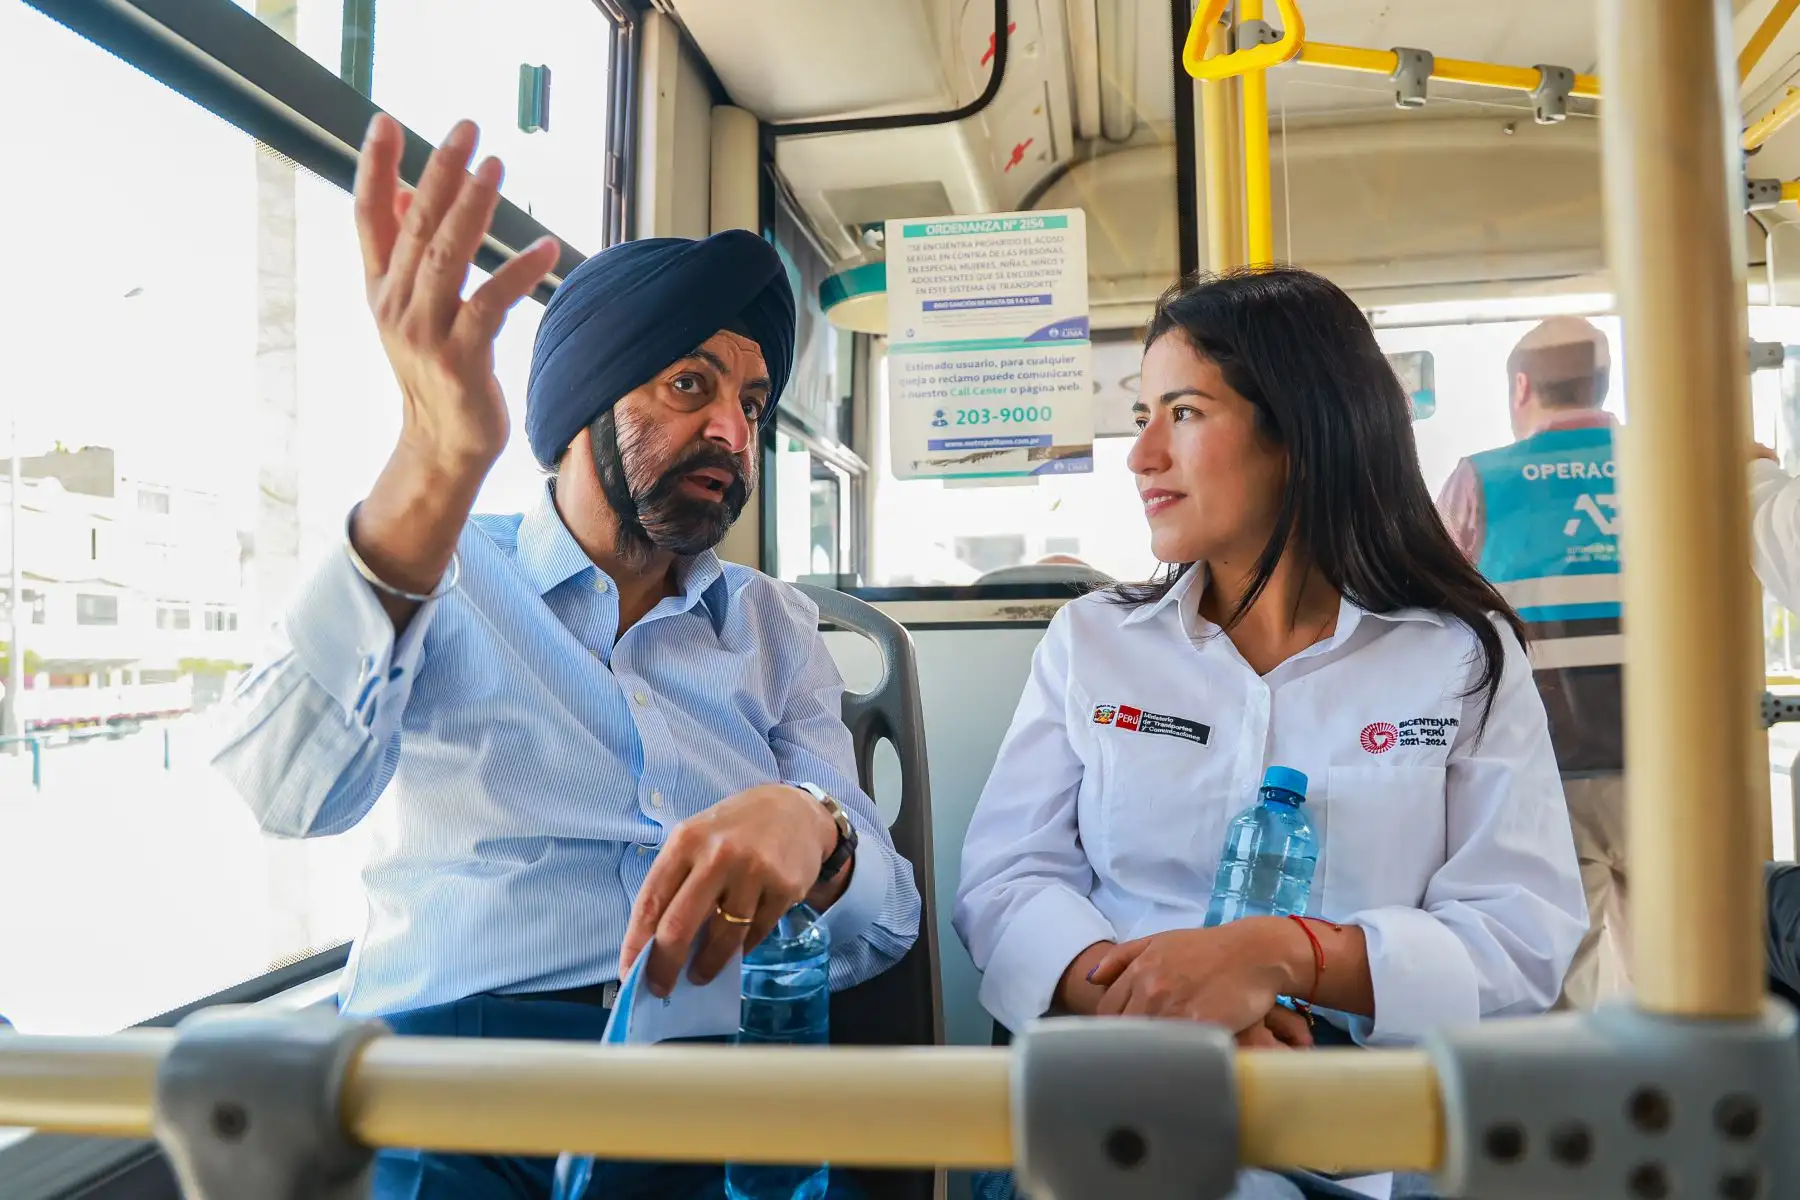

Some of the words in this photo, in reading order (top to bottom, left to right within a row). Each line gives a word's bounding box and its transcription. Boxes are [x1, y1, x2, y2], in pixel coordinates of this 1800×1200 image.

[926, 220, 1001, 236] ORDENANZA
[1020, 217, 1044, 229] 2154
[923, 241, 973, 251] ENCUENTRA
[975, 238, 1021, 247] PROHIBIDO
[1035, 235, 1064, 244] ACOSO
[906, 254, 936, 263] SEXUAL
[942, 253, 950, 261] EN
[952, 251, 987, 260] CONTRA
[1001, 248, 1017, 256] LAS
[908, 265, 918, 273] EN
[921, 264, 957, 273] ESPECIAL
[1030, 257, 1057, 266] NIÑOS
[912, 273, 974, 284] ADOLESCENTES
[976, 271, 992, 280] QUE
[995, 271, 1003, 279] SE
[1006, 268, 1062, 279] ENCUENTREN
[915, 287, 926, 295] EN
[928, 286, 946, 294] ESTE
[949, 284, 985, 293] SISTEMA
[986, 283, 996, 291] DE
[904, 360, 953, 372] Estimado
[956, 357, 997, 370] usuario,
[1001, 358, 1024, 369] para
[1026, 353, 1075, 366] cualquier
[899, 374, 927, 387] queja
[929, 376, 936, 384] o
[939, 373, 980, 384] reclamo
[983, 371, 1015, 383] puede
[1017, 368, 1084, 379] comunicarse
[908, 389, 948, 399] nuestro
[950, 386, 970, 396] Call
[972, 385, 1007, 396] Center
[1010, 386, 1017, 394] o
[956, 406, 1052, 425] 203-9000
[1118, 712, 1139, 725] PERÚ
[1144, 712, 1174, 723] Ministerio
[1142, 718, 1151, 726] de
[1153, 719, 1193, 733] Transportes
[1149, 725, 1201, 741] Comunicaciones
[1399, 729, 1416, 737] DEL
[1420, 727, 1445, 737] PERÚ
[1400, 738, 1447, 746] 2021-2024
